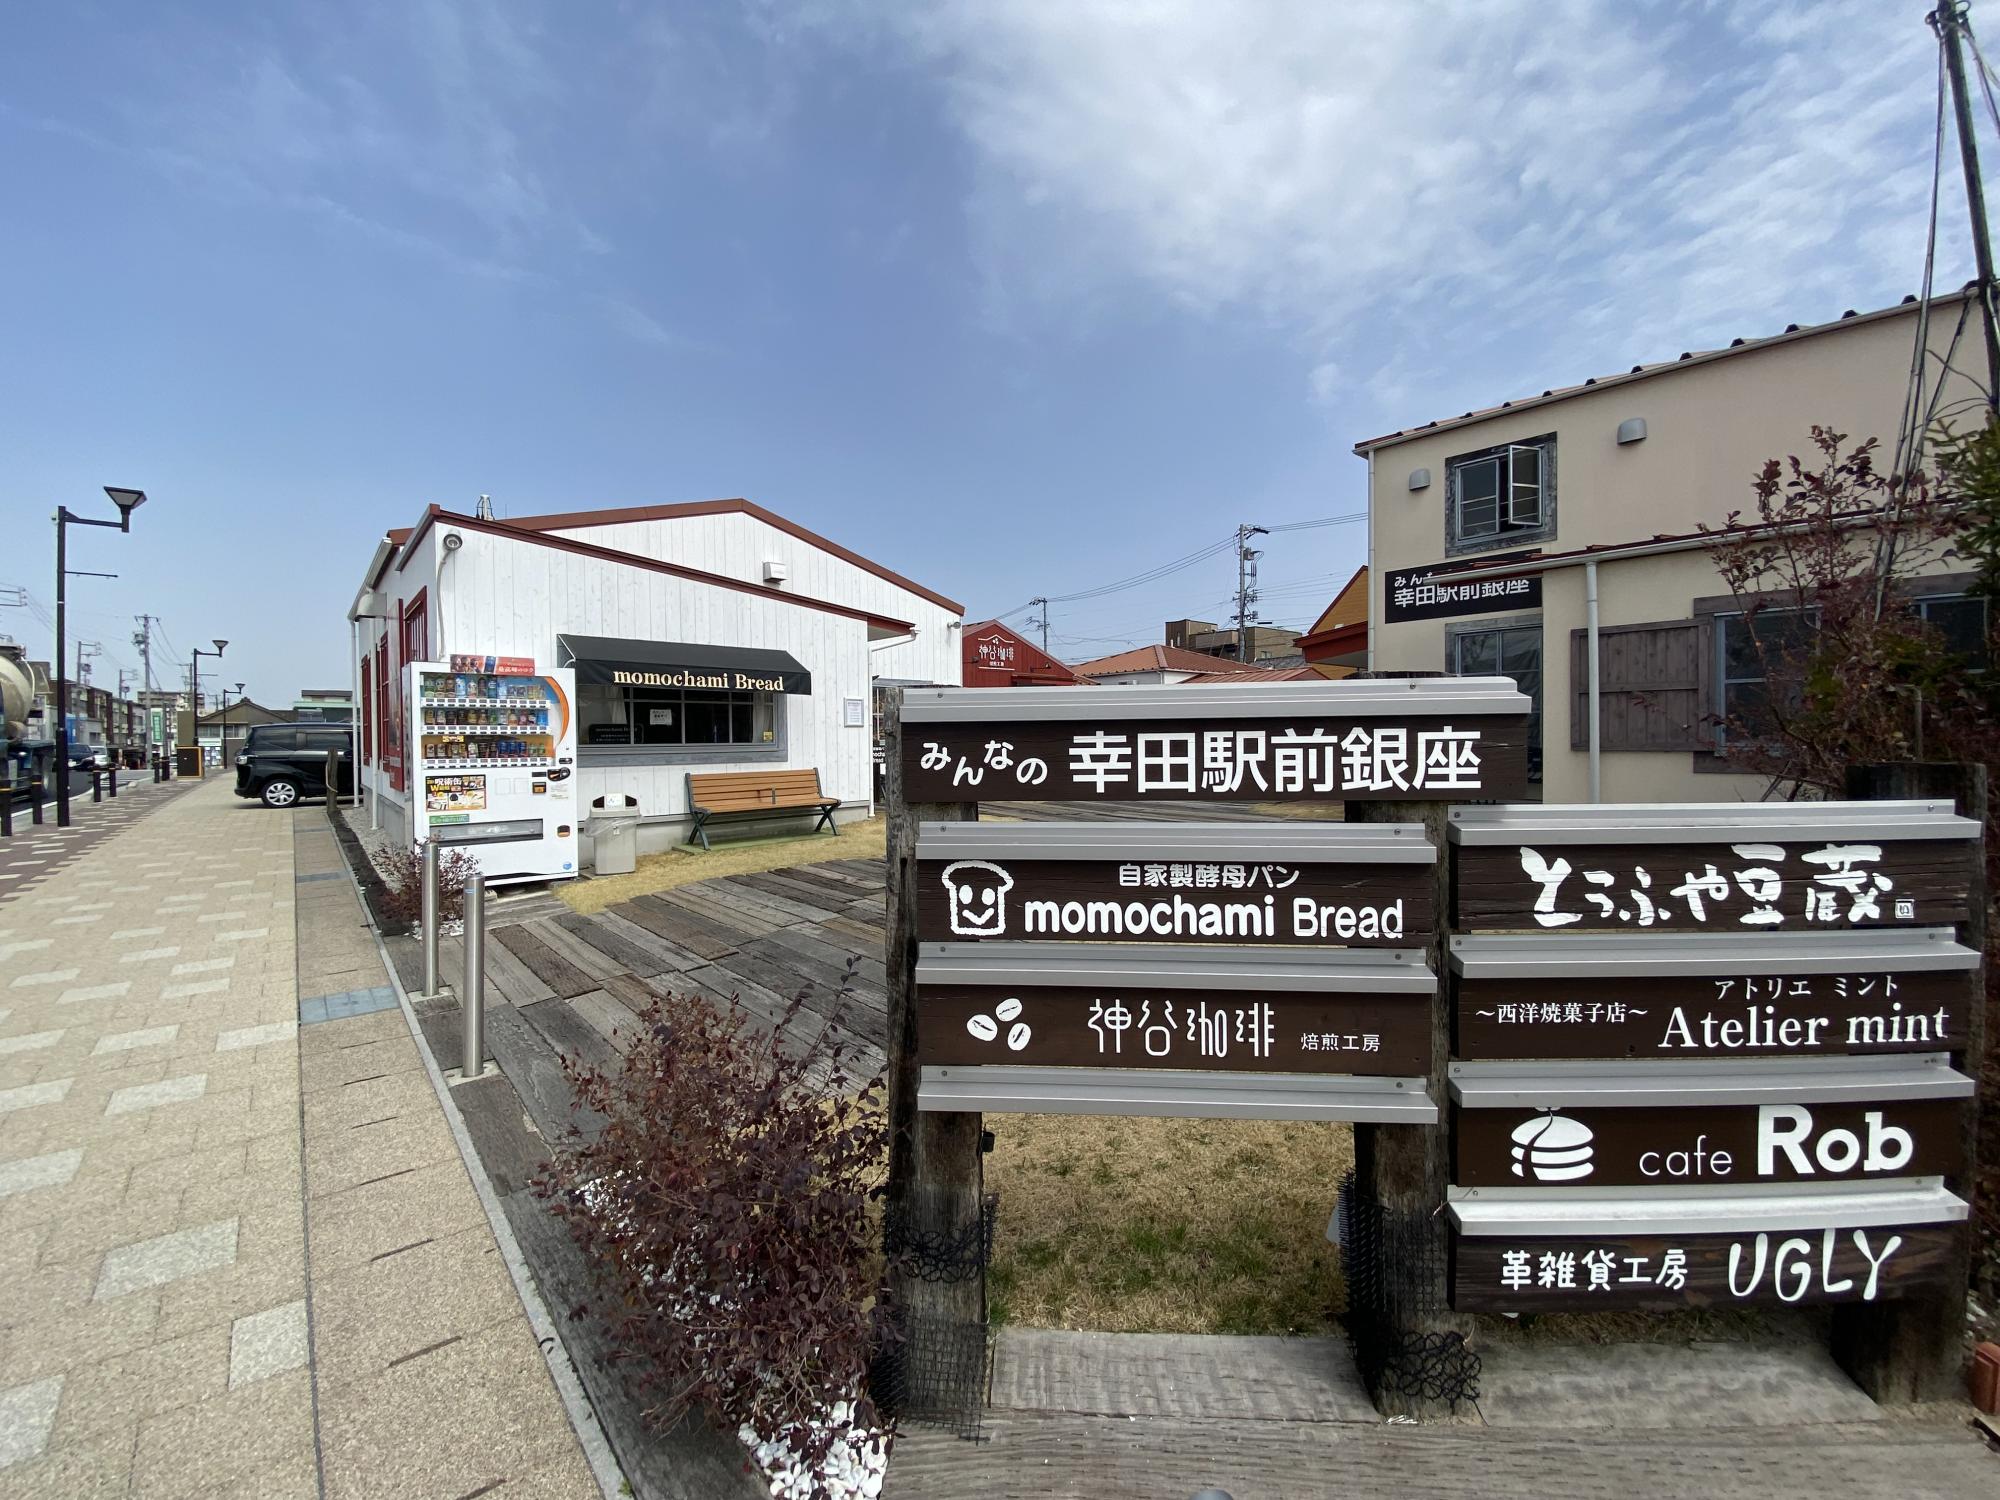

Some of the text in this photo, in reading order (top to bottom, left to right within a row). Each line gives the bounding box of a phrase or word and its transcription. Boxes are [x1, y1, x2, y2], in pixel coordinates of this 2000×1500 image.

[613, 671, 784, 691] momochami Bread
[920, 725, 1482, 794] みんなの 幸田駅前銀座
[1118, 862, 1300, 889] 自家製酵母パン
[1024, 894, 1403, 939] momochami Bread
[1715, 974, 1899, 1000] アトリエ ミント
[1087, 998, 1275, 1058] 神谷珈琲
[1300, 1032, 1381, 1052] 焙煎工房
[1657, 1002, 1950, 1048] Atelier mint
[1639, 1104, 1914, 1176] cafe Rob
[1500, 1228, 1902, 1302] 革雑貨工房 UGLY
